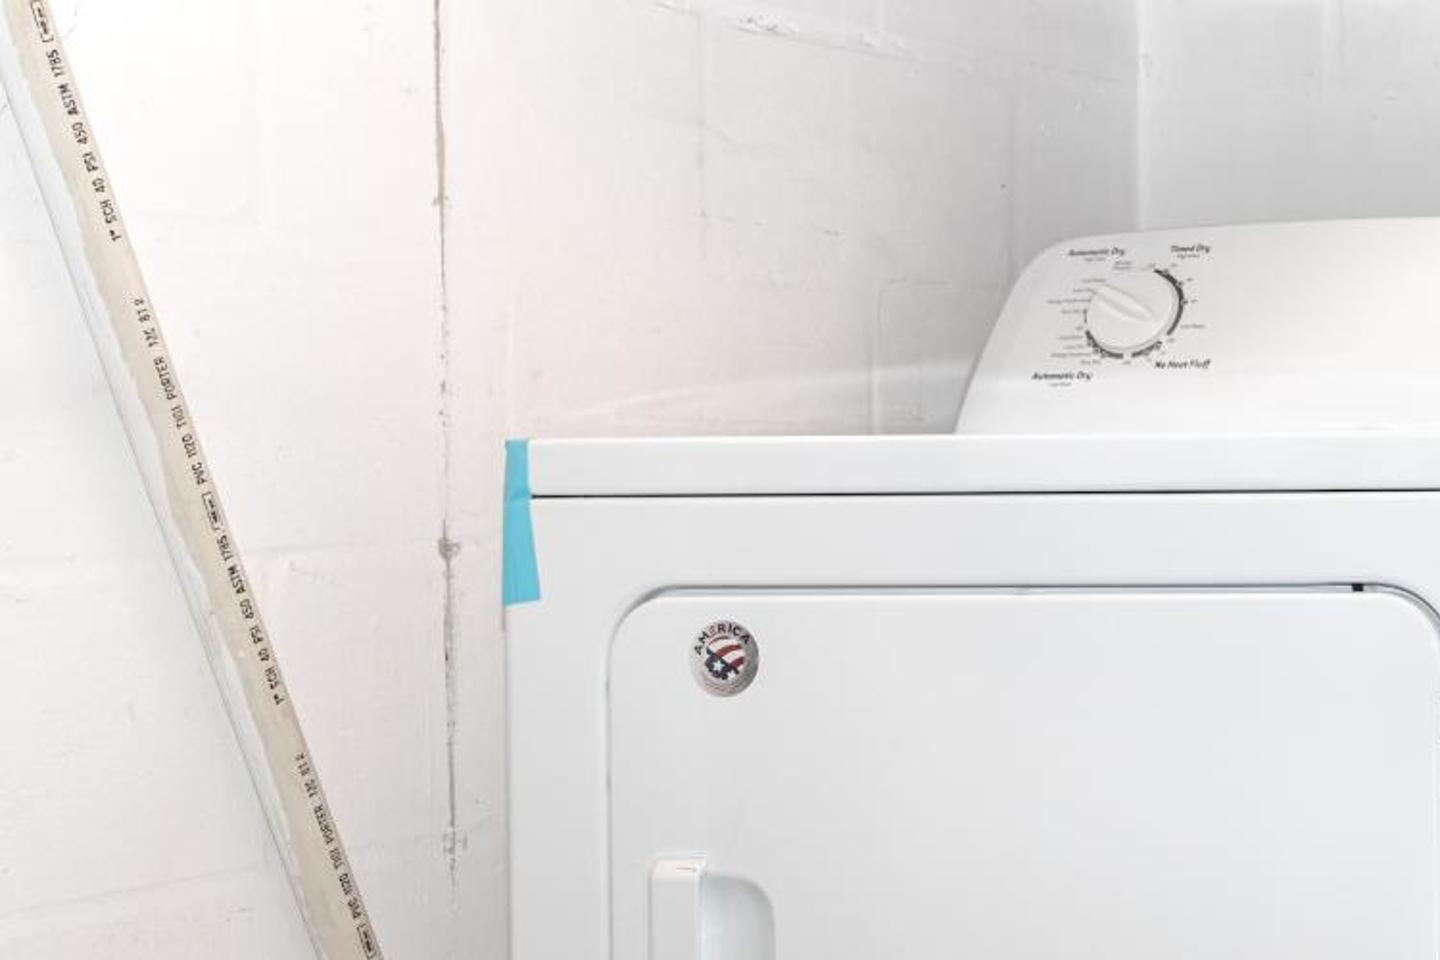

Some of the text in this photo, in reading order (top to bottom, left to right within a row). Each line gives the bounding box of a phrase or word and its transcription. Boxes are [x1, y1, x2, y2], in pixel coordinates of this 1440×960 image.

[45, 48, 65, 78] 1785
[57, 82, 79, 116] ASTM
[71, 121, 89, 145] 450
[82, 151, 99, 173] PSI
[91, 177, 106, 193] 40
[99, 199, 118, 225] SCH
[191, 461, 208, 486] PVC
[227, 565, 247, 595] ASTM
[693, 623, 751, 656] AMERICA
